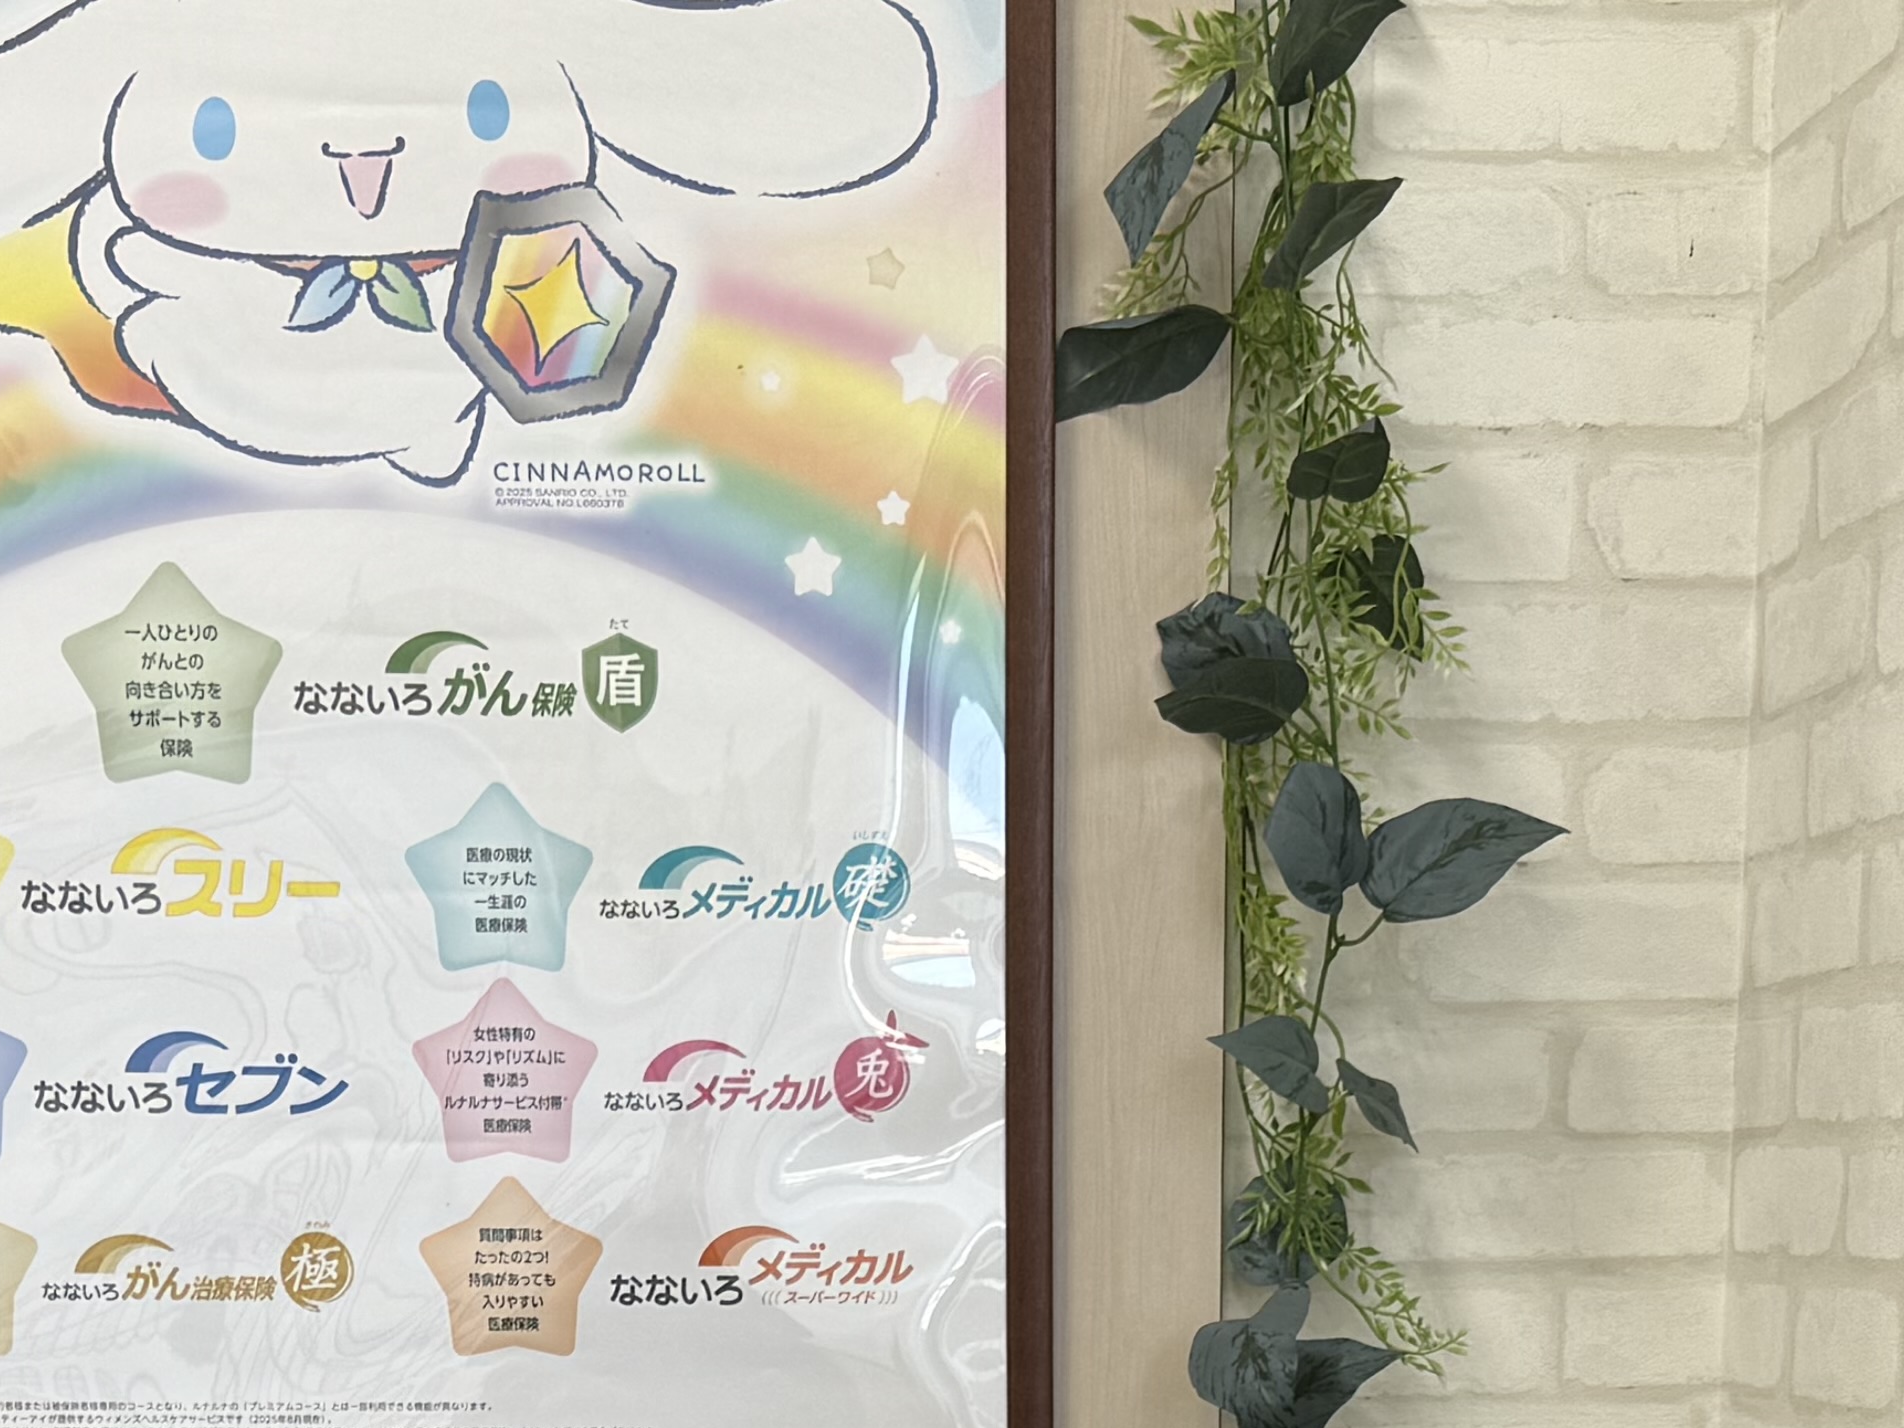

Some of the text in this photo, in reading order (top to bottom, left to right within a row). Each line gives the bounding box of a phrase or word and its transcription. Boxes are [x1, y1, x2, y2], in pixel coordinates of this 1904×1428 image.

[493, 459, 706, 483] CINNAMOROLL
[124, 623, 219, 643] 一人ひとりの
[140, 652, 205, 671] がんとの
[124, 681, 223, 701] 向き合い方を
[129, 709, 222, 729] サポートする
[159, 738, 194, 758] 保険
[465, 846, 533, 865] 医療の現状
[462, 870, 538, 889] にマッチした
[473, 893, 527, 911] 一生涯の
[474, 916, 528, 935] 医療保険
[473, 1026, 536, 1043] 女性特有の
[446, 1047, 567, 1066] 「リスク」や「リズム」に
[482, 1072, 529, 1089] 寄り添う
[482, 1117, 533, 1134] 医療保険
[478, 1226, 544, 1244] 質問事項は
[468, 1270, 556, 1289] 持病があっても
[481, 1293, 544, 1311] 入りやすい
[488, 1316, 540, 1333] 医療保険
